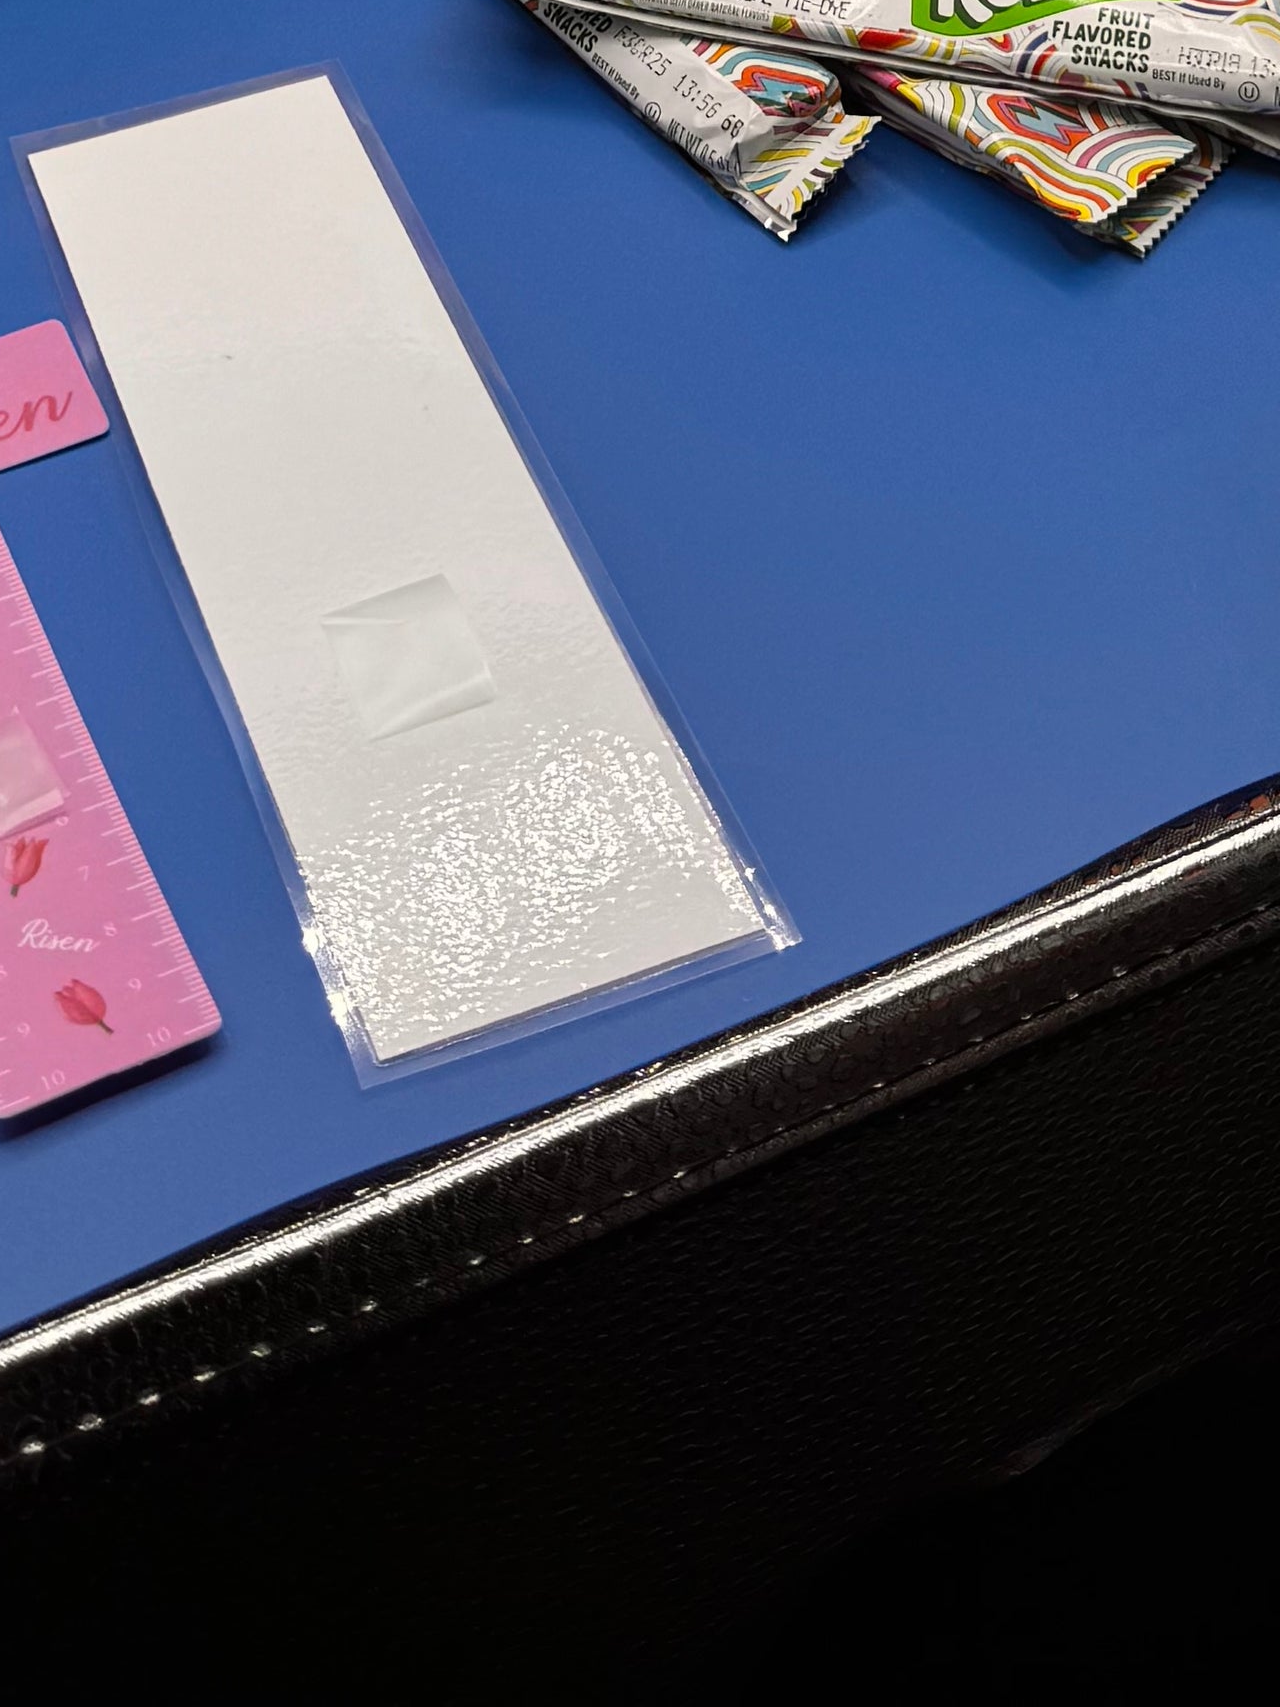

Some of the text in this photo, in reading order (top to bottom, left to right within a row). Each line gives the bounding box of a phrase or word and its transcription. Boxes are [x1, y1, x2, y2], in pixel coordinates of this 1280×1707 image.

[543, 2, 599, 53] SNACKS
[1097, 6, 1156, 30] FRUIT
[1051, 20, 1153, 50] FLAVORED
[1071, 44, 1151, 74] SNACKS
[1152, 68, 1178, 82] BEST
[1188, 73, 1212, 87] Used
[1213, 77, 1227, 91] By
[672, 73, 722, 119] 13:56
[18, 917, 98, 954] Risen
[146, 1028, 172, 1047] 10
[40, 1071, 66, 1090] 10
